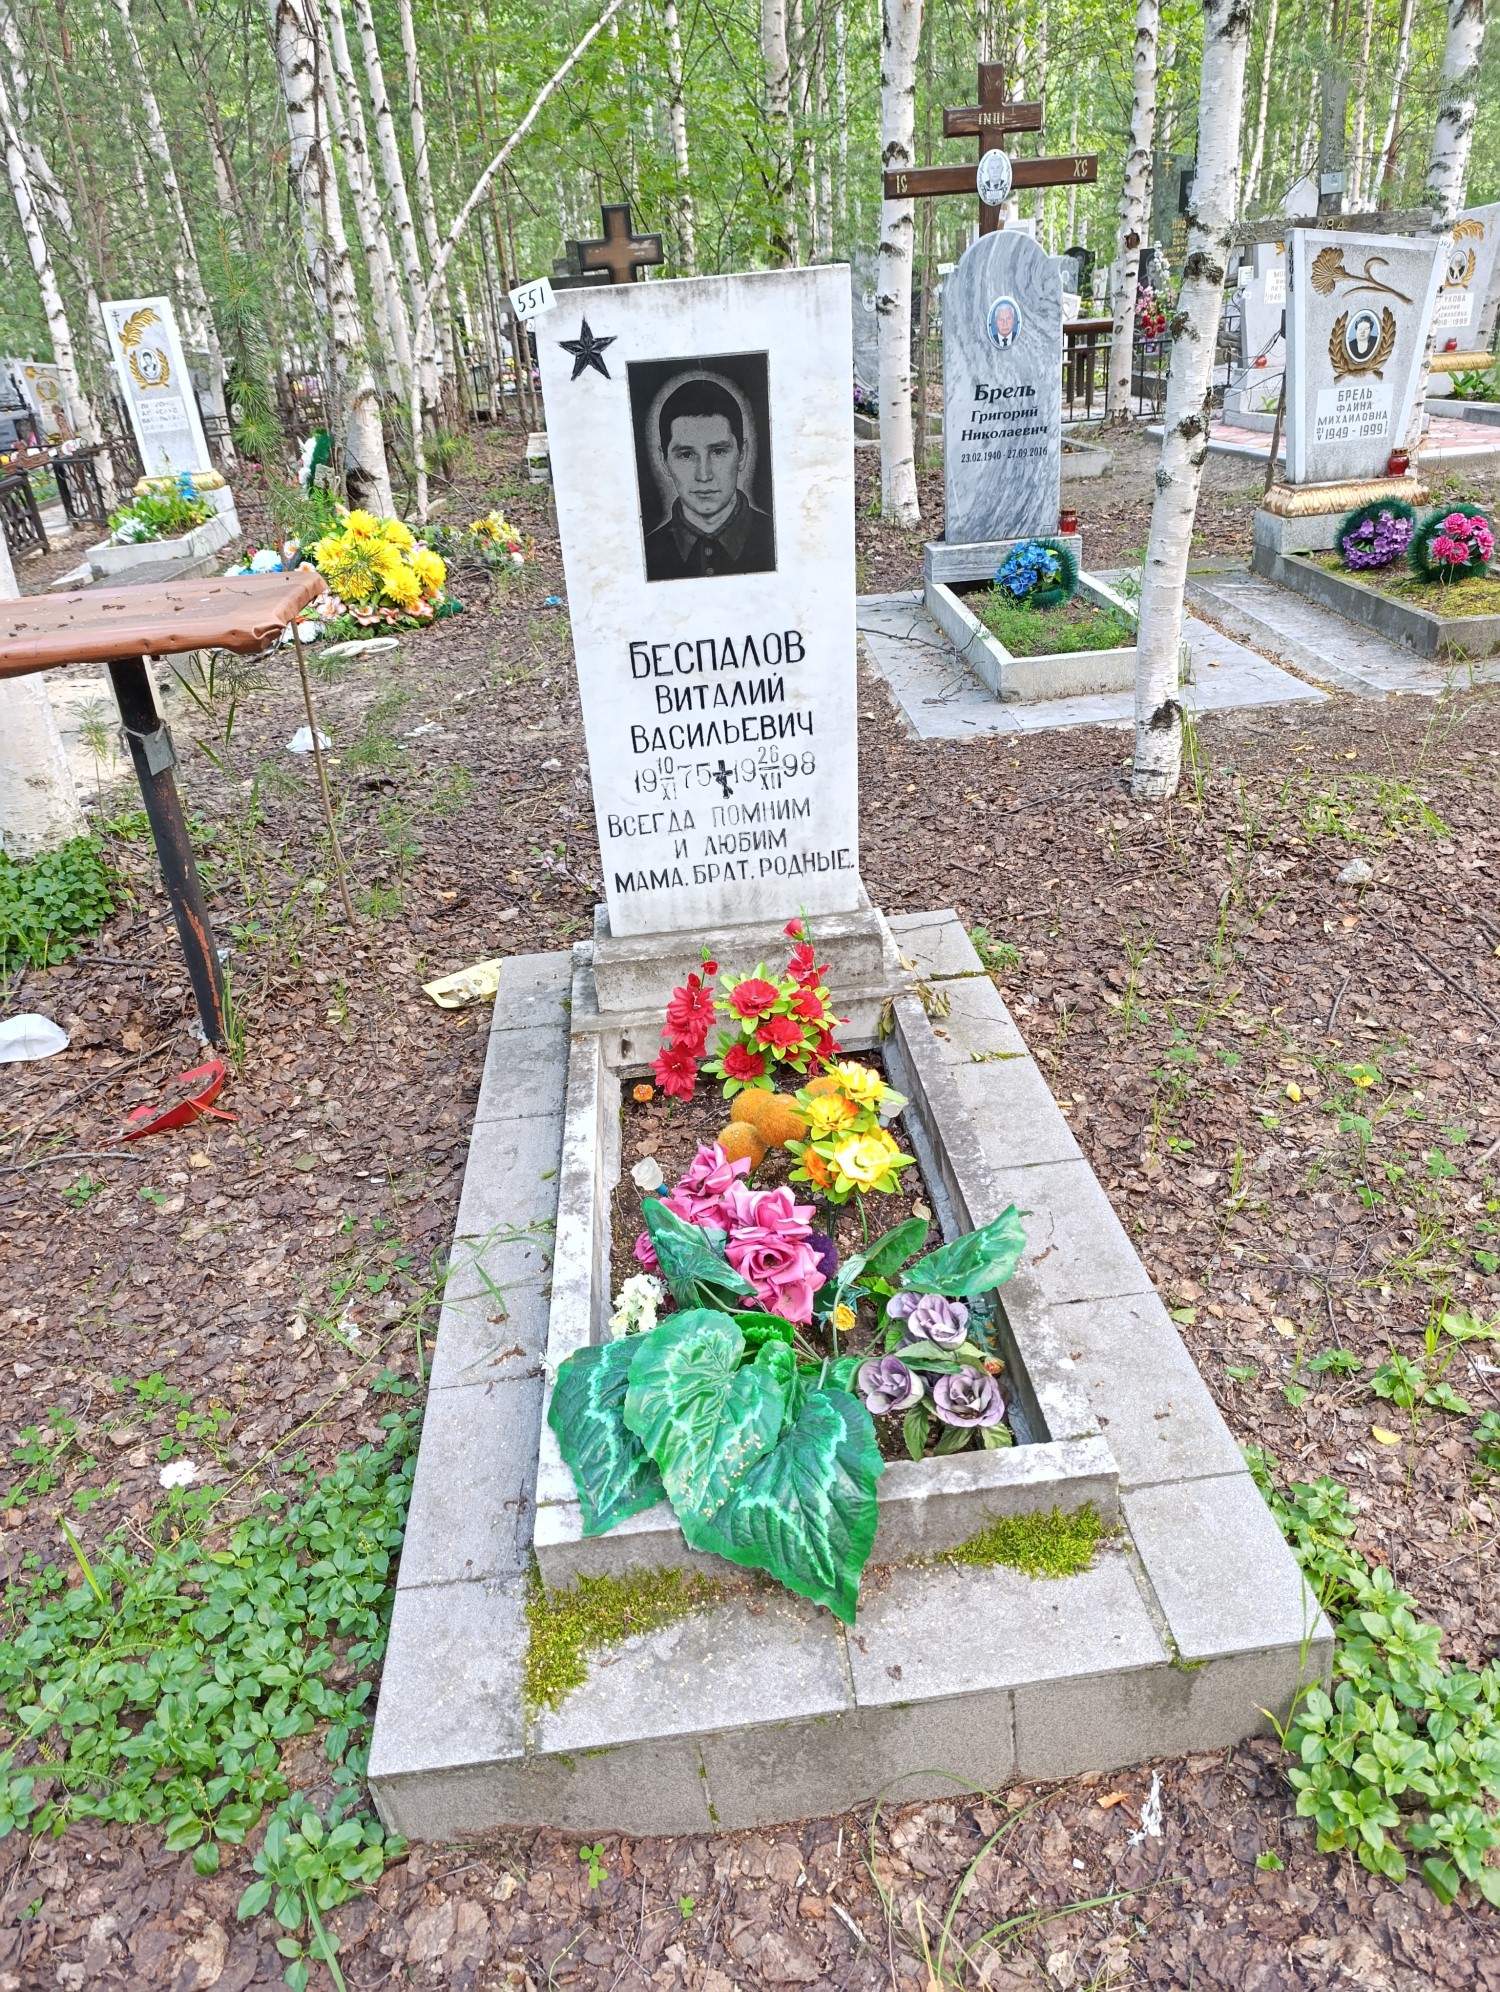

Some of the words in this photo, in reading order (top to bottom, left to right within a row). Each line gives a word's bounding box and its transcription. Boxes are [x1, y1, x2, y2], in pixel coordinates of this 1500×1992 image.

[517, 286, 545, 313] 551
[973, 384, 1036, 404] Брель
[1337, 388, 1373, 402] БРЕЛЬ
[970, 405, 1039, 424] Григорий
[1336, 401, 1372, 413] ФАИНА
[1317, 410, 1388, 426] МИХАИЛОВНА
[961, 426, 1048, 442] Николаевич
[1325, 426, 1349, 440] 1949
[1360, 423, 1383, 437] 1999
[961, 450, 1002, 463] 23.02.1940
[1007, 446, 1048, 459] 27.09.2016
[628, 630, 806, 679] БЕСПАЛОВ
[654, 672, 786, 714] ВИТАЛИЙ
[630, 711, 814, 754] ВАСИЛЬЕВИЧ
[607, 809, 697, 838] ВСЕГДА
[711, 797, 811, 828] ПОМНИМ
[674, 838, 688, 859] И
[704, 828, 788, 857] ЛЮБИМ
